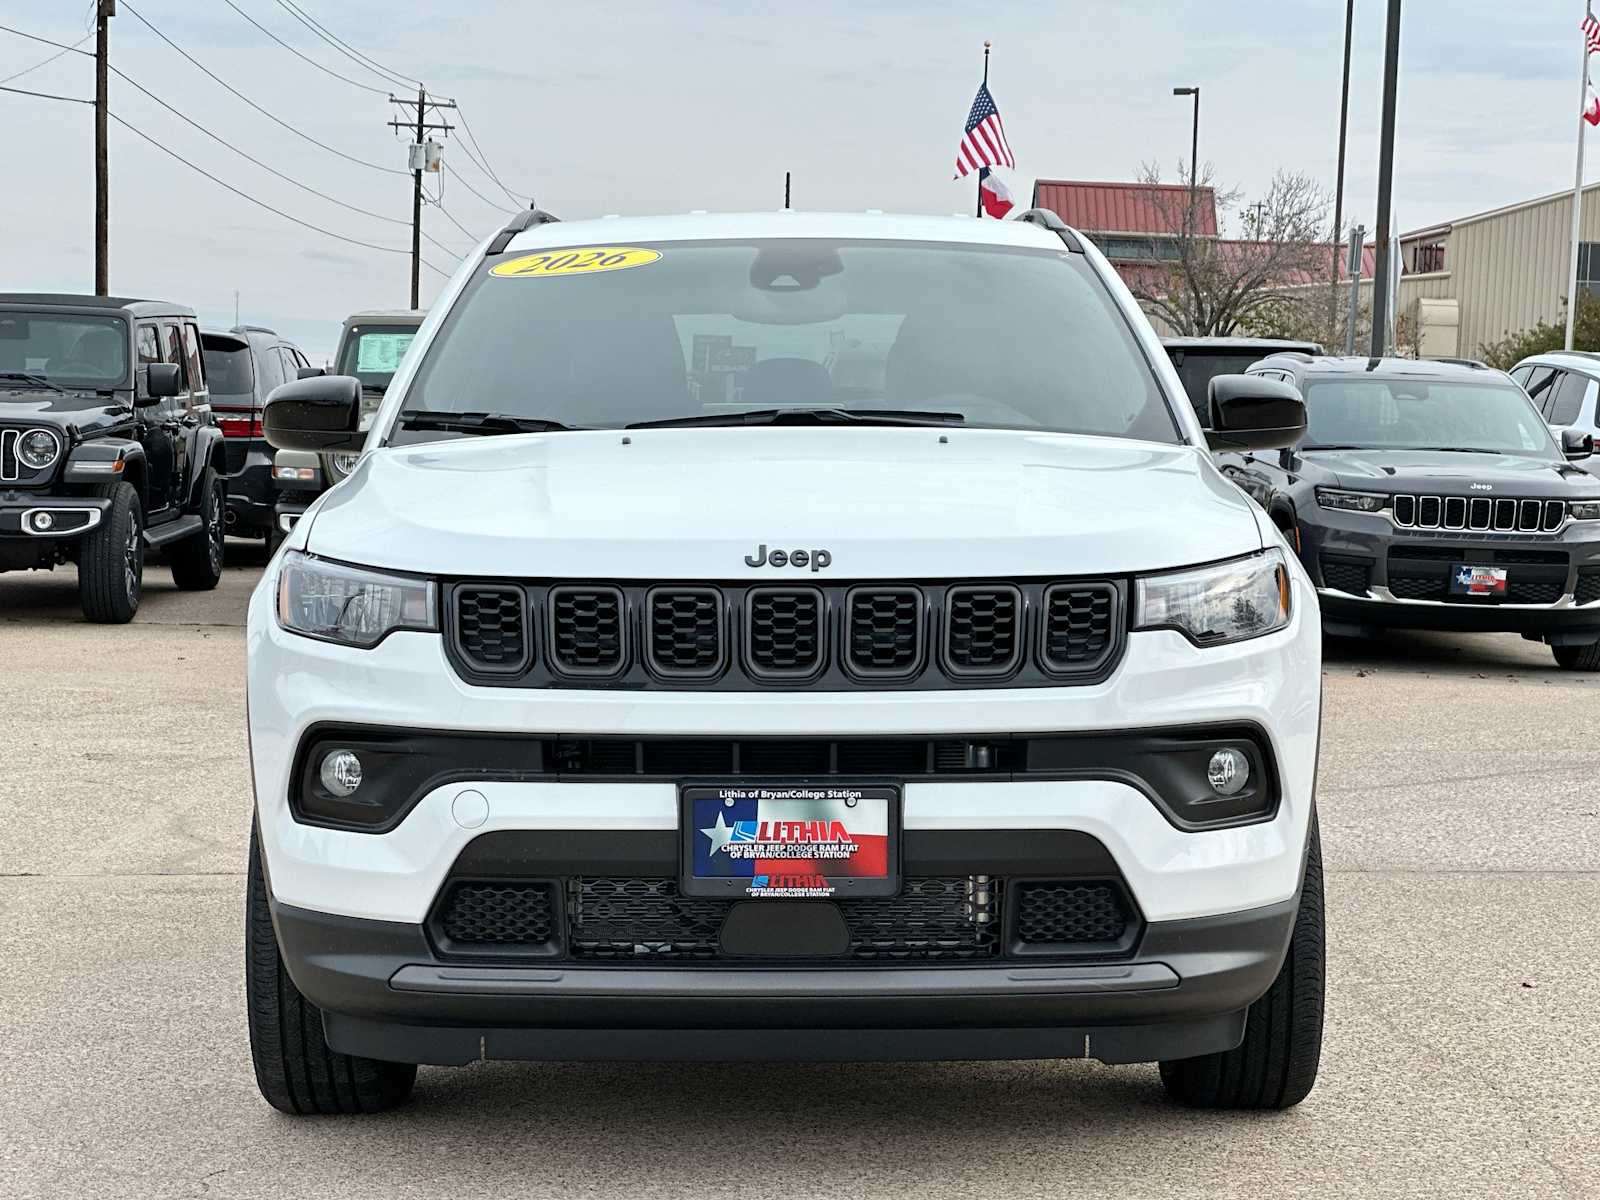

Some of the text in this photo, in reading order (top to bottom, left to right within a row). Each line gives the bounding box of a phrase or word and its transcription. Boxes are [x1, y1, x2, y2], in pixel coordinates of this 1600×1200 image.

[513, 251, 637, 274] 2026
[1470, 482, 1493, 490] Jeep
[744, 544, 832, 572] Jeep
[719, 790, 862, 800] Lithia of Bryan/College Station
[758, 821, 852, 843] LITHIA
[721, 844, 859, 852] CHRYSLER JEEP DODGE RAM FIAT
[730, 851, 850, 859] OF BRYAN/COLLEGE STATION
[769, 875, 830, 888] LITHIA
